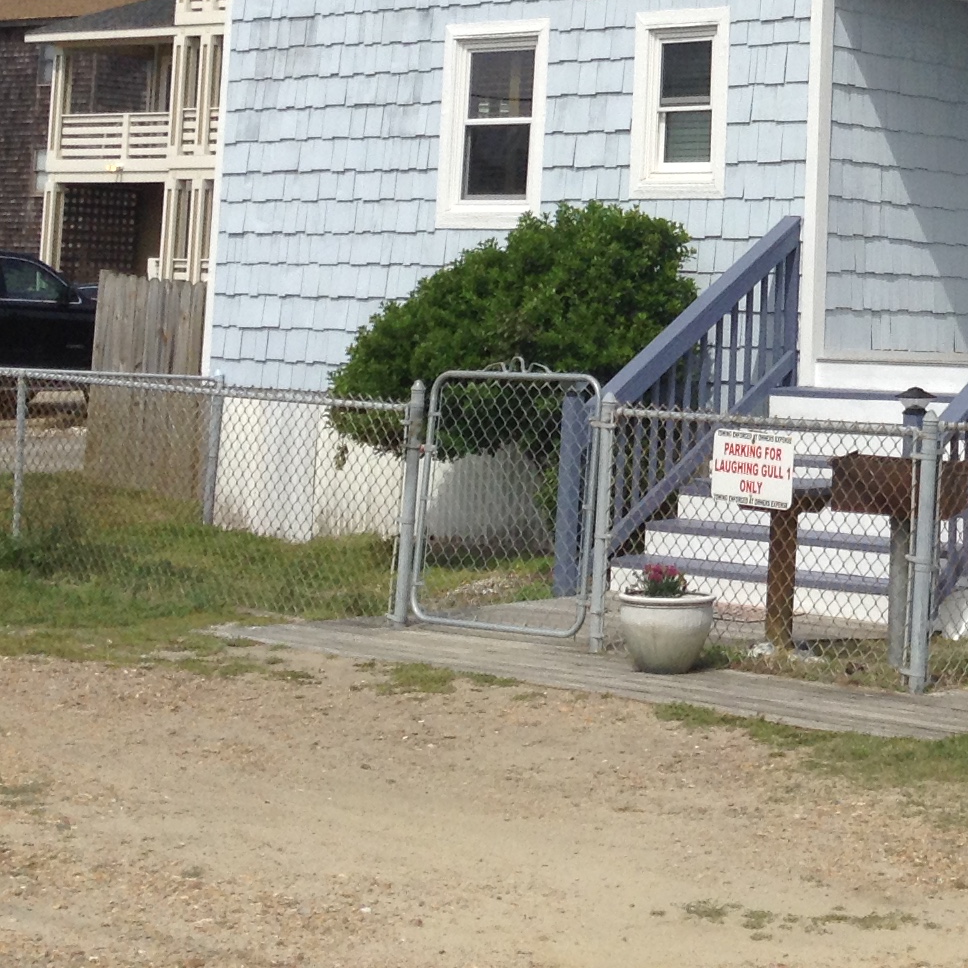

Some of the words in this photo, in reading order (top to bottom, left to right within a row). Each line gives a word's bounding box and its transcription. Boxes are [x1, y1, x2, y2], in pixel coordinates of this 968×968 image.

[724, 442, 762, 459] PARKING
[764, 446, 782, 461] FOR
[714, 458, 759, 476] LAUGHING
[761, 464, 783, 480] GULL
[786, 467, 791, 481] 1
[740, 479, 763, 494] ONLY
